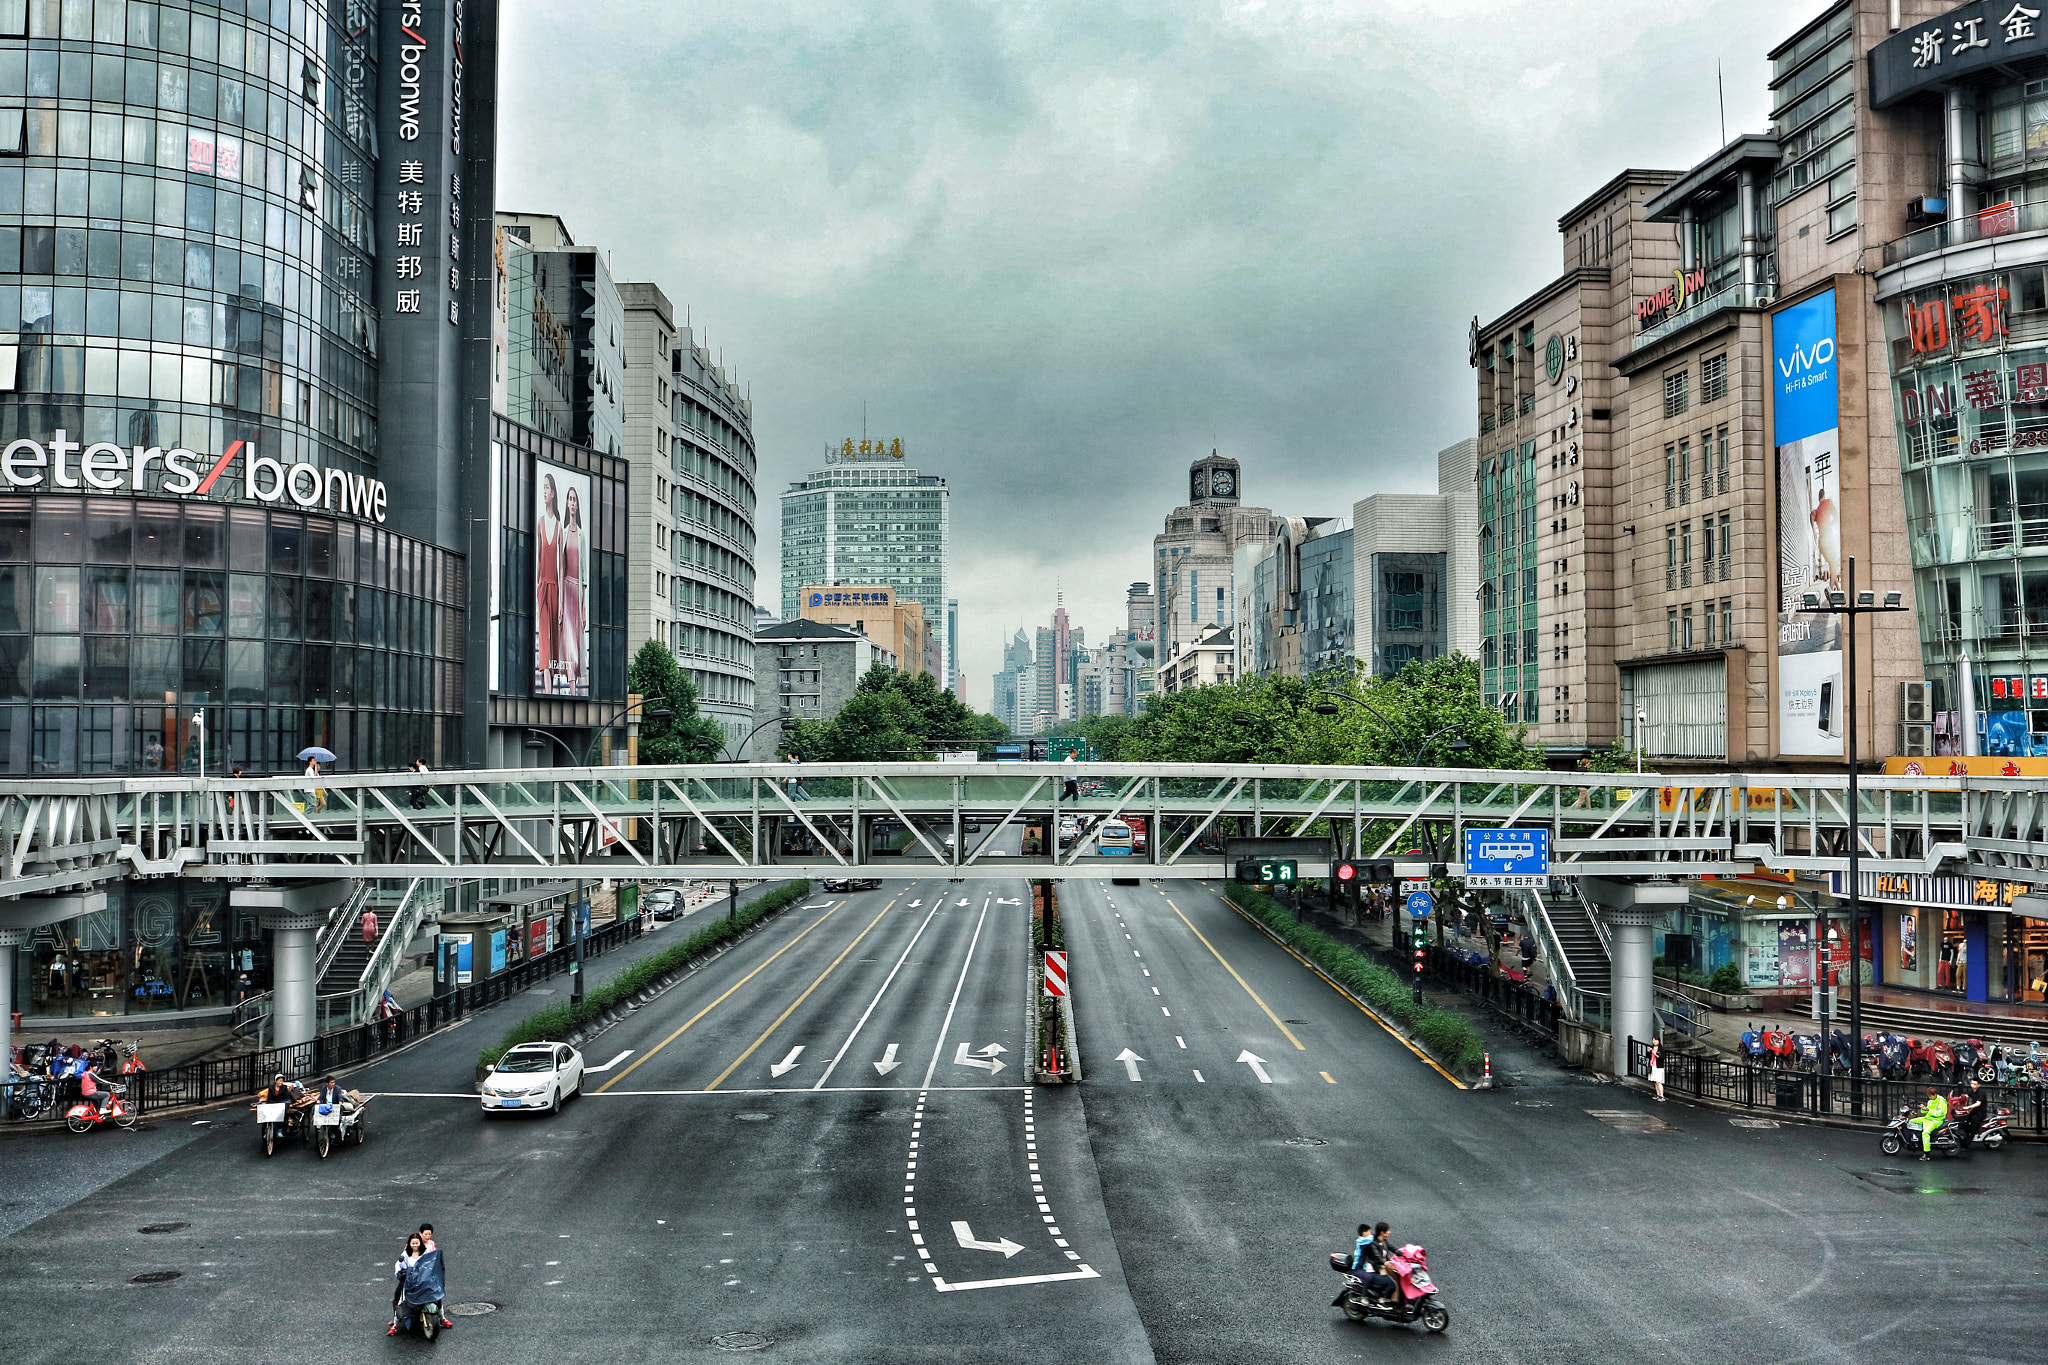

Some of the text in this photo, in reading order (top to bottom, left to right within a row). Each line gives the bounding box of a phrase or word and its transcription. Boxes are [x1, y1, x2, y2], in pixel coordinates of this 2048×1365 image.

[1911, 2, 2041, 68] 浙江金
[400, 0, 427, 141] rs/bonwe
[396, 160, 424, 314] 美特斯邦威
[1637, 284, 1675, 321] HOME
[1904, 284, 2010, 359] 如家
[1779, 337, 1834, 378] vivo
[1785, 379, 1801, 394] Hi-Fi
[1807, 369, 1828, 387] Smart
[1902, 381, 1951, 427] DN
[1970, 437, 1996, 456] 6F
[824, 592, 889, 602] 中国太平洋保险
[1483, 832, 1531, 841] 公交专用
[1402, 882, 1429, 891] 全路段
[1469, 877, 1544, 886] 双休、节假日开放
[1877, 876, 1910, 894] HLA
